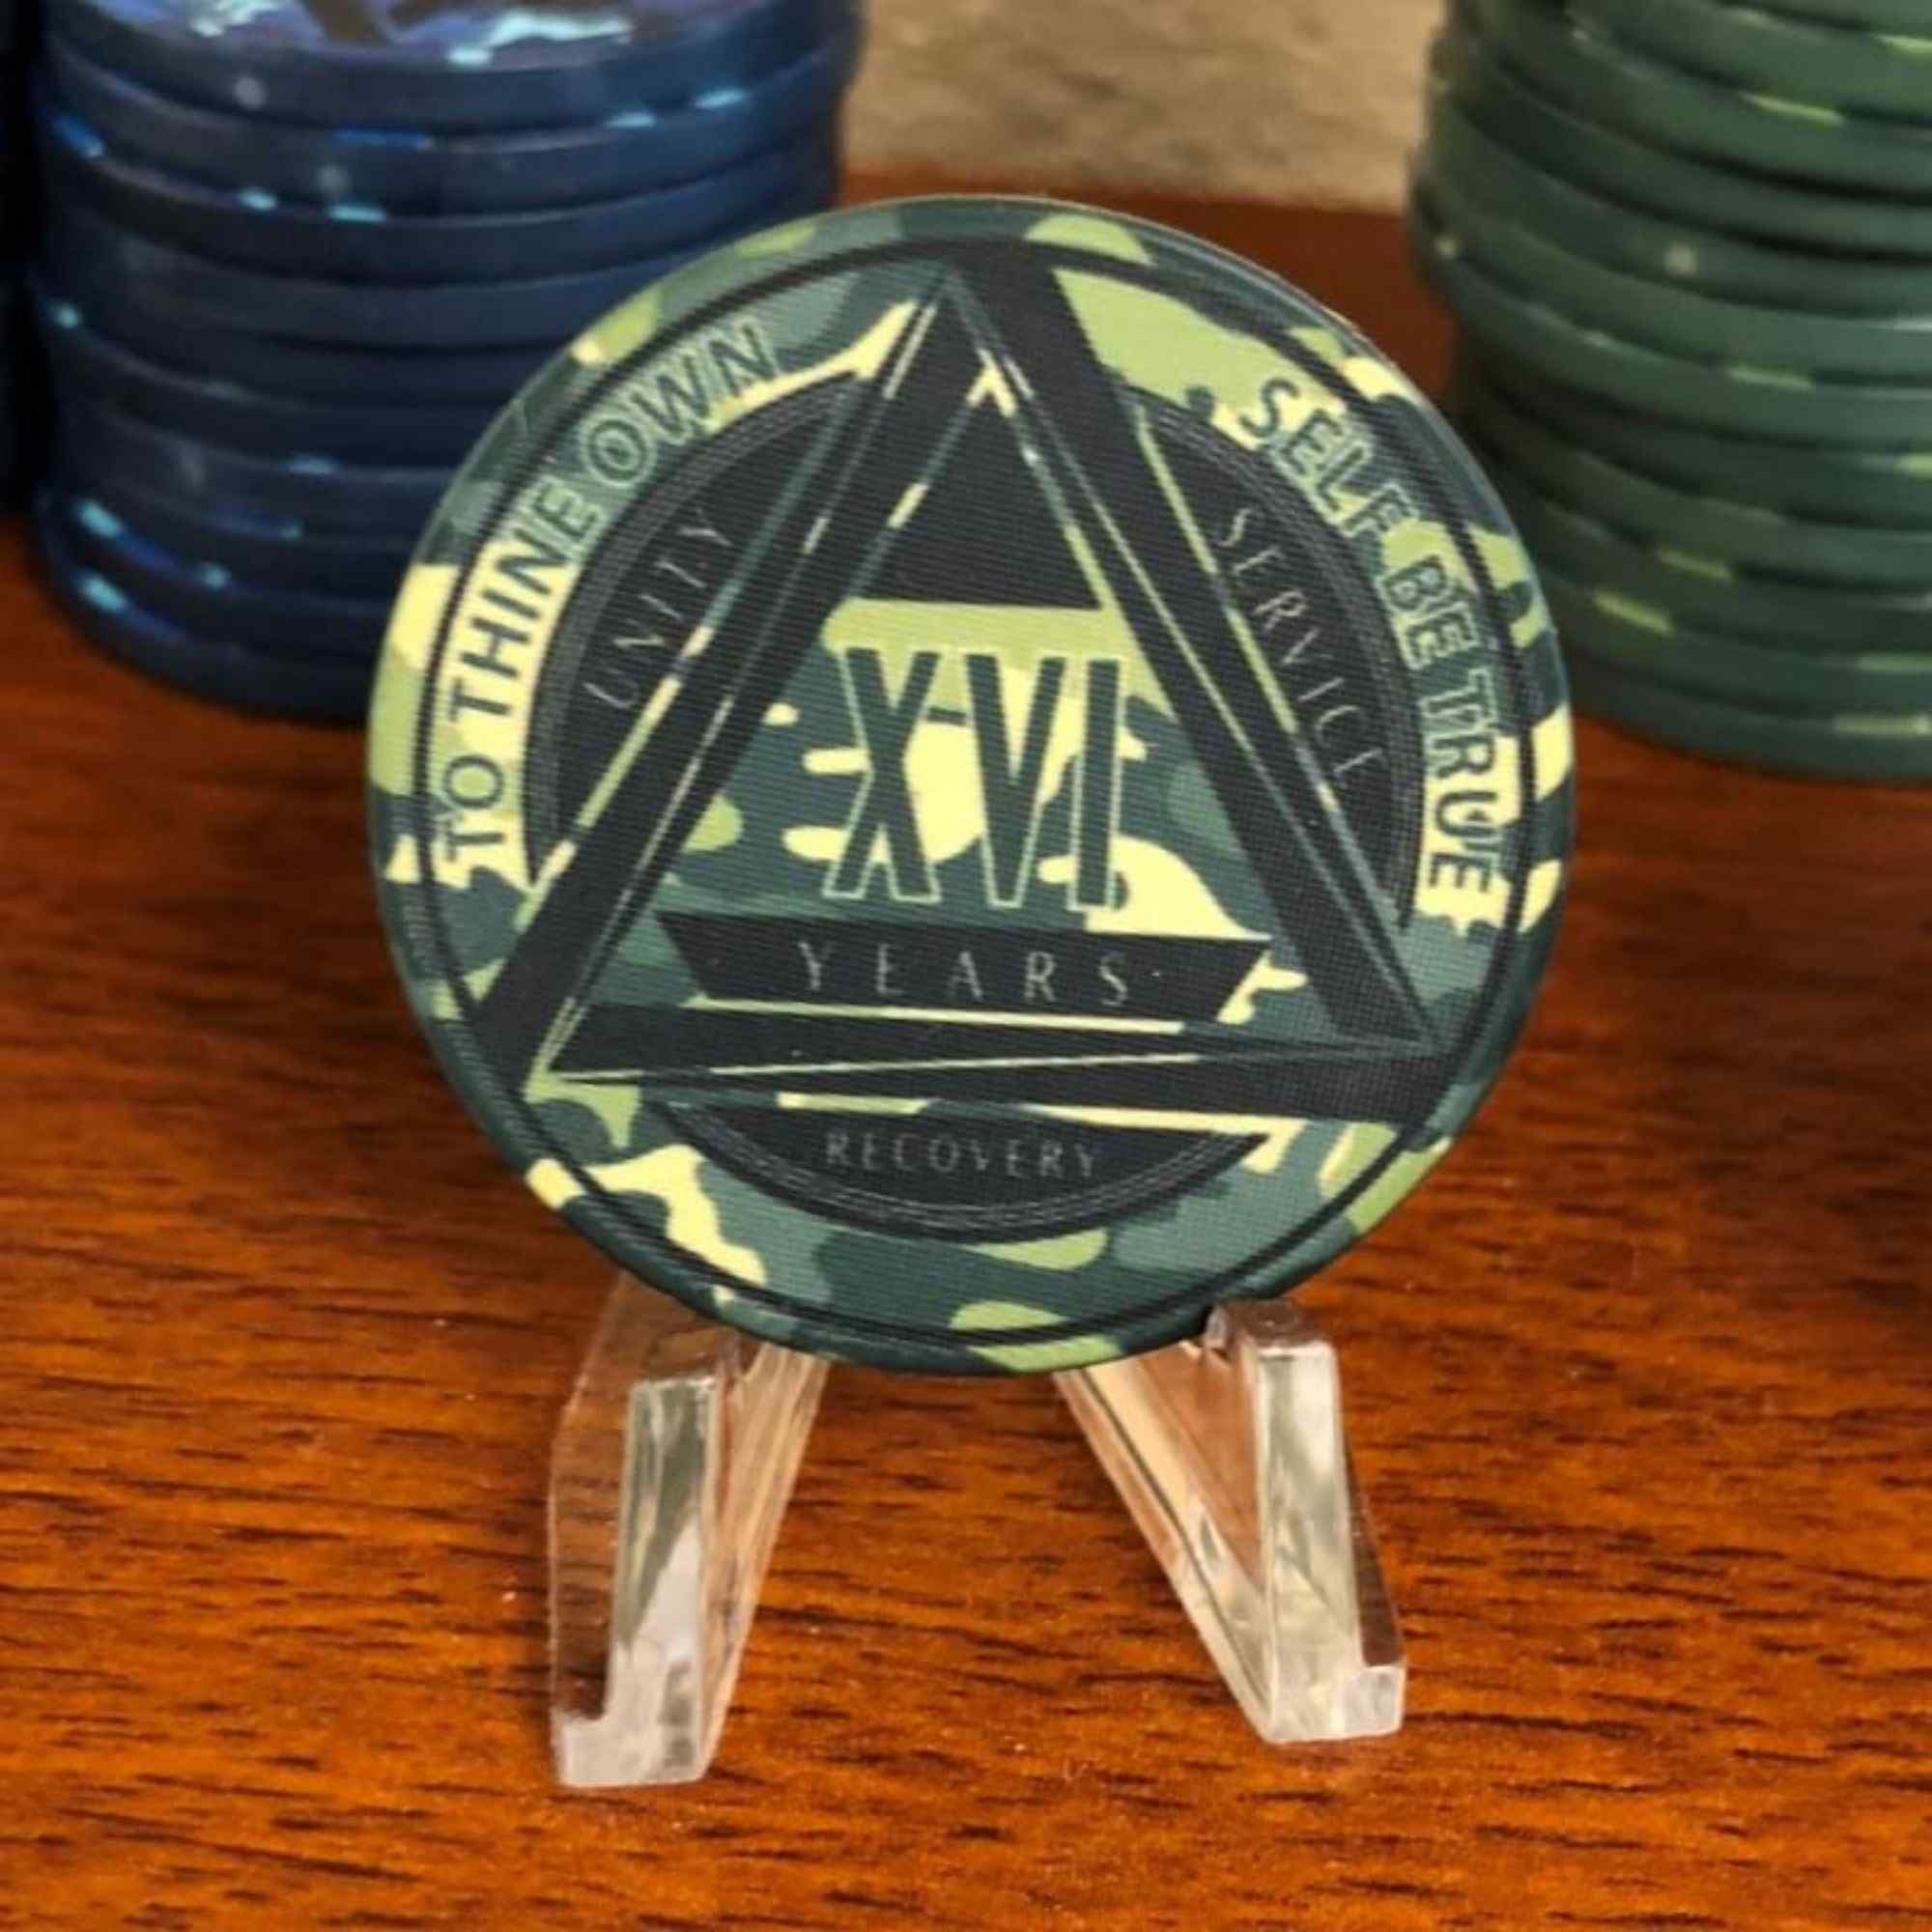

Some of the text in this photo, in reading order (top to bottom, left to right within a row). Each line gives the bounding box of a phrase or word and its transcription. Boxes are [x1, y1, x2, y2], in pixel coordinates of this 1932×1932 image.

[441, 319, 781, 862] TO THINE OWN
[583, 508, 731, 710] UNITY
[1215, 505, 1385, 786] SERVICE
[1236, 377, 1504, 894] SELF BE TRUE
[821, 644, 1122, 911] XVI
[796, 941, 1130, 1007] YEARS
[824, 1130, 1099, 1179] RECOVERY
